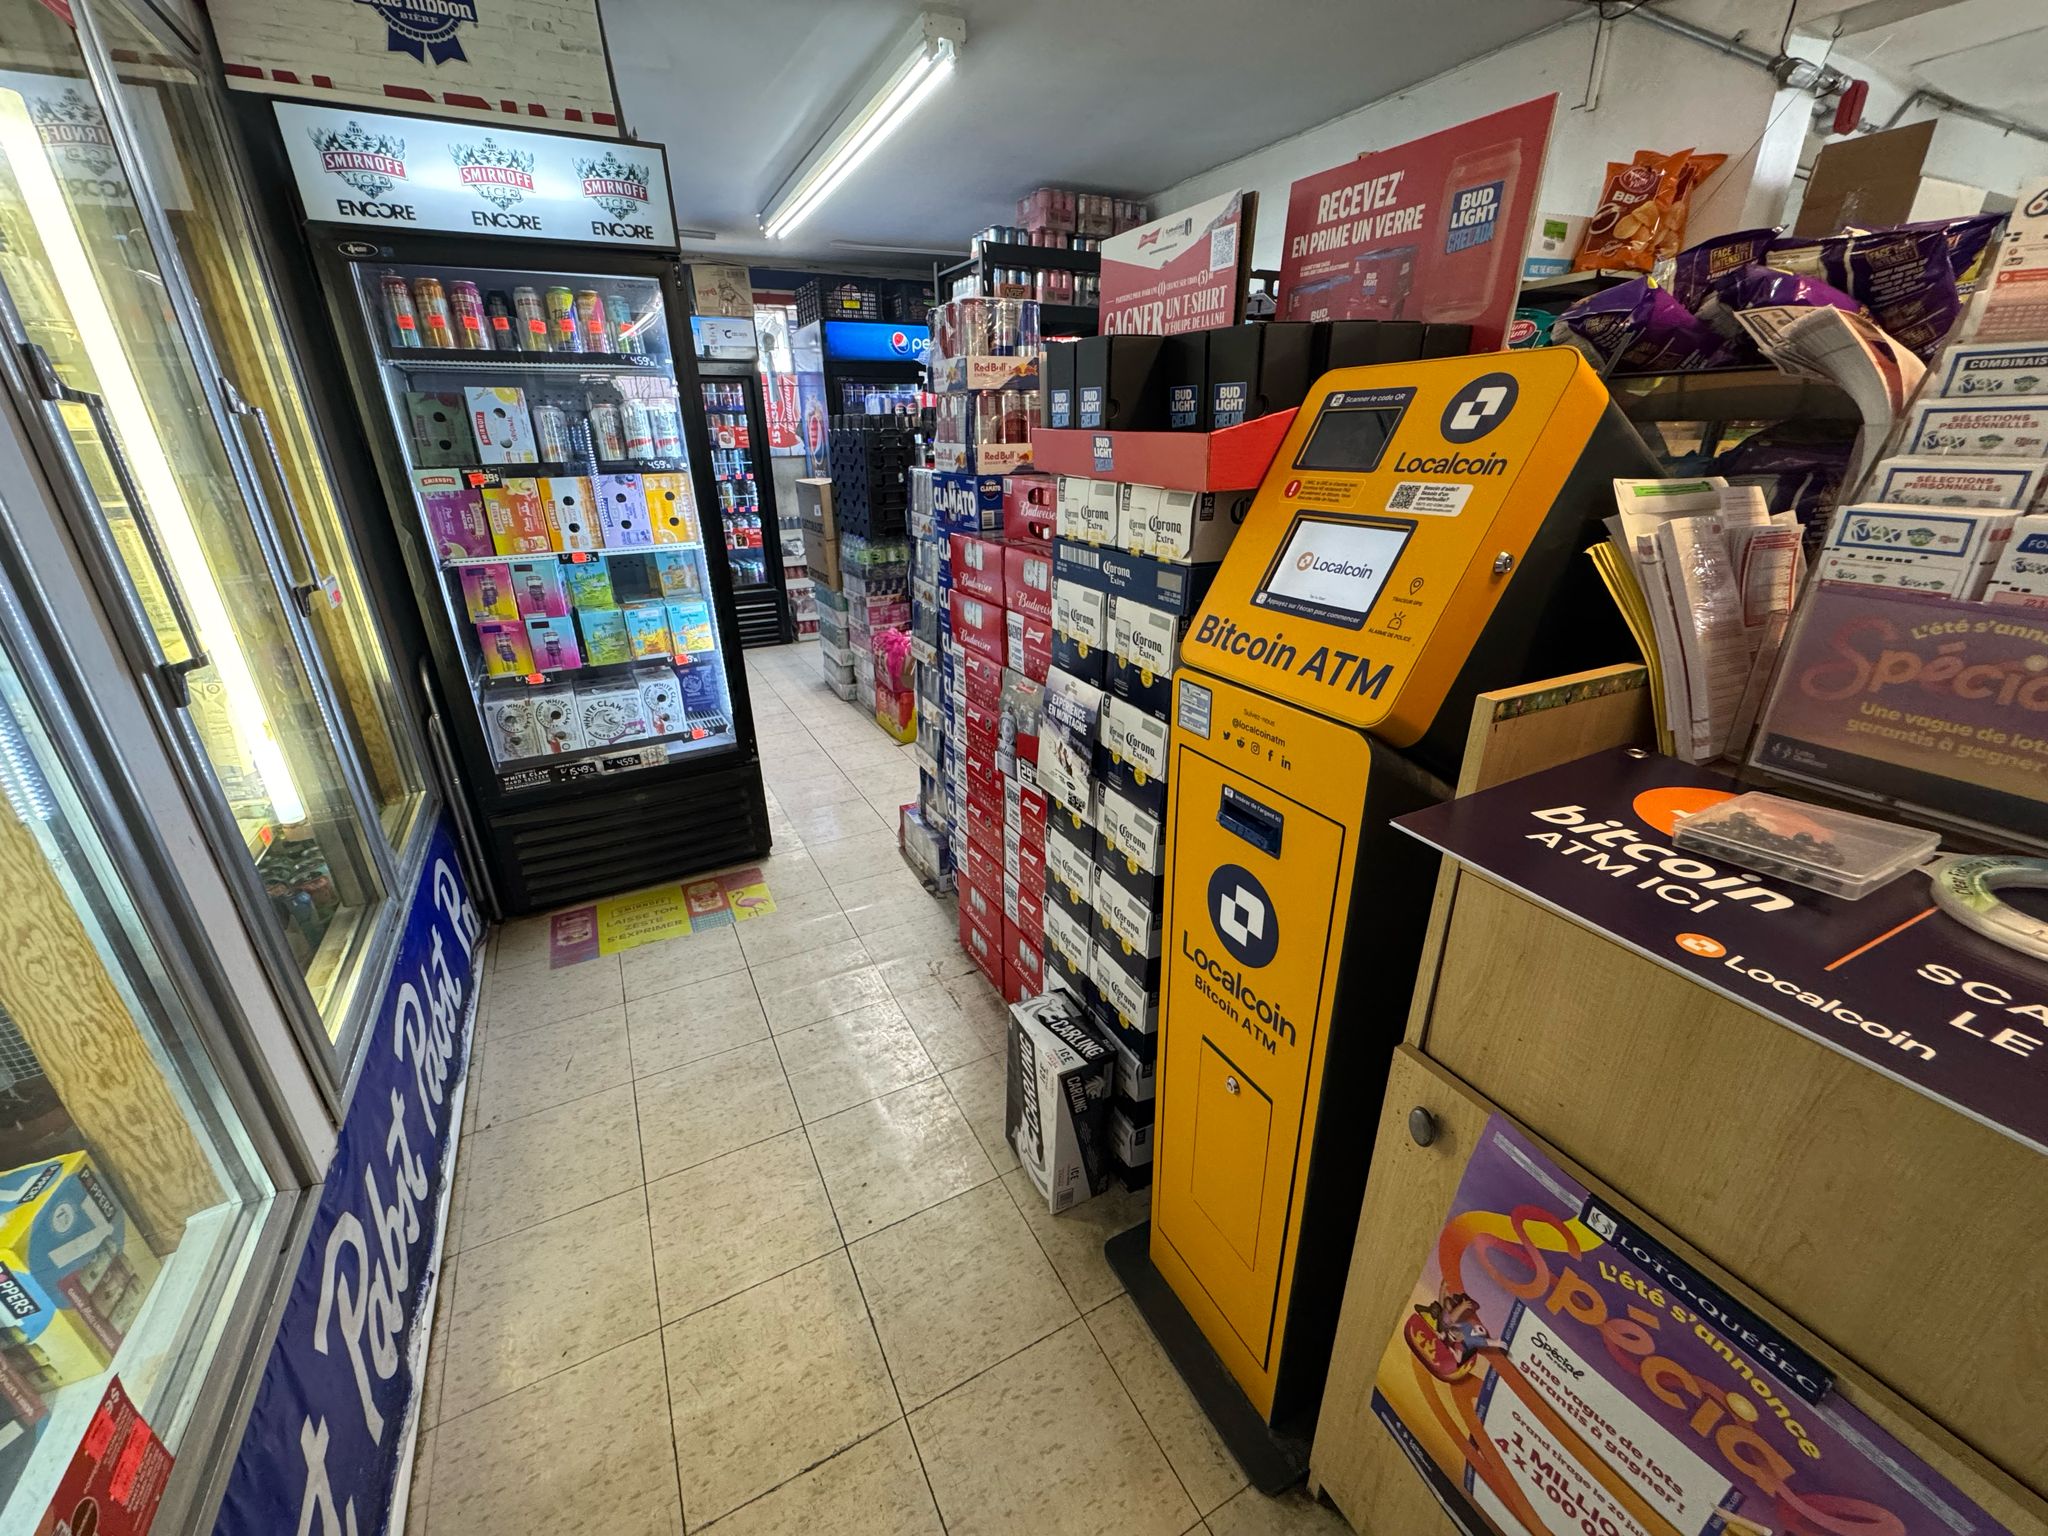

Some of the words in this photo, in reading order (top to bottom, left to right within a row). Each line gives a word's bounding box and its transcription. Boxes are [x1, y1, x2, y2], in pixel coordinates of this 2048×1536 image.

[323, 151, 404, 177] SMIRNOFF
[462, 167, 534, 189] SMIRNOFF
[583, 179, 647, 201] SMIRNOFF
[336, 199, 416, 221] ENCORE
[1460, 186, 1495, 210] BUD
[471, 210, 542, 231] ENCORE
[1450, 202, 1499, 230] LIGHT
[591, 221, 655, 240] ENCORE
[1292, 232, 1308, 259] EN
[1310, 220, 1351, 255] PRIME
[1352, 217, 1375, 244] UN
[1375, 203, 1426, 240] VERRE
[1104, 300, 1163, 335] GAGNER
[1166, 296, 1181, 320] UN
[1183, 284, 1228, 316] T-SHIRT
[1192, 316, 1201, 330] DE
[1083, 390, 1098, 402] BUD
[1174, 388, 1193, 401] BUD
[1215, 399, 1244, 411] LIGHT
[1220, 386, 1241, 399] BUD
[1345, 394, 1371, 404] Scanner
[1371, 394, 1378, 402] le
[1378, 394, 1394, 403] code
[1394, 392, 1406, 402] QR
[1081, 401, 1100, 413] LIGHT
[1171, 400, 1196, 412] LIGHT
[1094, 447, 1113, 459] LIGHT
[1095, 437, 1110, 448] BUD
[1394, 452, 1508, 476] Localcoin
[933, 486, 977, 517] CLAMATO
[1081, 504, 1110, 522] Corona
[1204, 496, 1214, 507] 12
[1087, 518, 1104, 531] Extra
[1149, 514, 1183, 535] Corona
[1155, 531, 1175, 546] Extra
[1103, 560, 1132, 580] Corona
[1312, 556, 1374, 580] Localcoin
[960, 571, 993, 593] Budweiser
[1071, 608, 1095, 628] Corona
[1267, 596, 1288, 609] Appuyez
[1327, 610, 1361, 625] commencer
[959, 627, 992, 651] Budweiser
[1132, 630, 1164, 654] Corona
[1195, 614, 1297, 672] Bitcoin
[1298, 646, 1395, 701] ATM
[583, 703, 597, 730] WHITE
[597, 700, 624, 713] CLAW
[1048, 703, 1057, 716] EN
[1056, 706, 1088, 736] MONTAGNE
[1860, 701, 1902, 721] Une
[1904, 712, 1974, 737] vague
[1976, 726, 2007, 744] de
[1126, 731, 1157, 759] Corona
[1232, 717, 1286, 747] @localcoinatm
[1846, 717, 1935, 750] garantis
[1937, 736, 1954, 752] à
[1119, 823, 1147, 852] Corona
[1530, 804, 1796, 913] bitcoin
[1525, 831, 1640, 878] ATM
[1638, 875, 1720, 914] ICI
[1183, 929, 1297, 1048] Localcoin
[1194, 974, 1239, 1023] Bitcoin
[1241, 1017, 1277, 1056] ATM
[1724, 953, 1938, 1061] Localcoin
[1051, 1018, 1105, 1059] CARLING
[1949, 1010, 2045, 1058] LE
[1060, 1047, 1074, 1063] ICE
[1019, 1032, 1040, 1129] CARLING
[1066, 1075, 1088, 1114] CARLING
[314, 1086, 427, 1446] Pabst
[1618, 1234, 1819, 1397] LOTO-QUÉBEC
[1530, 1331, 1585, 1381] Spécial
[1597, 1260, 1667, 1308] L'été
[1669, 1303, 1822, 1460] s'annonce
[1519, 1361, 1588, 1427] garantis
[1590, 1426, 1603, 1440] à
[1603, 1440, 1676, 1504] gagner
[1530, 1353, 1561, 1387] Une
[1563, 1386, 1618, 1438] vague
[1619, 1435, 1644, 1461] de
[1647, 1456, 1684, 1498] lots
[1511, 1431, 1525, 1453] 1
[1512, 1410, 1552, 1450] Grand
[1552, 1449, 1592, 1490] tirage
[1495, 1438, 1510, 1454] 4
[1512, 1457, 1529, 1473] x
[1530, 1470, 1577, 1520] 100
